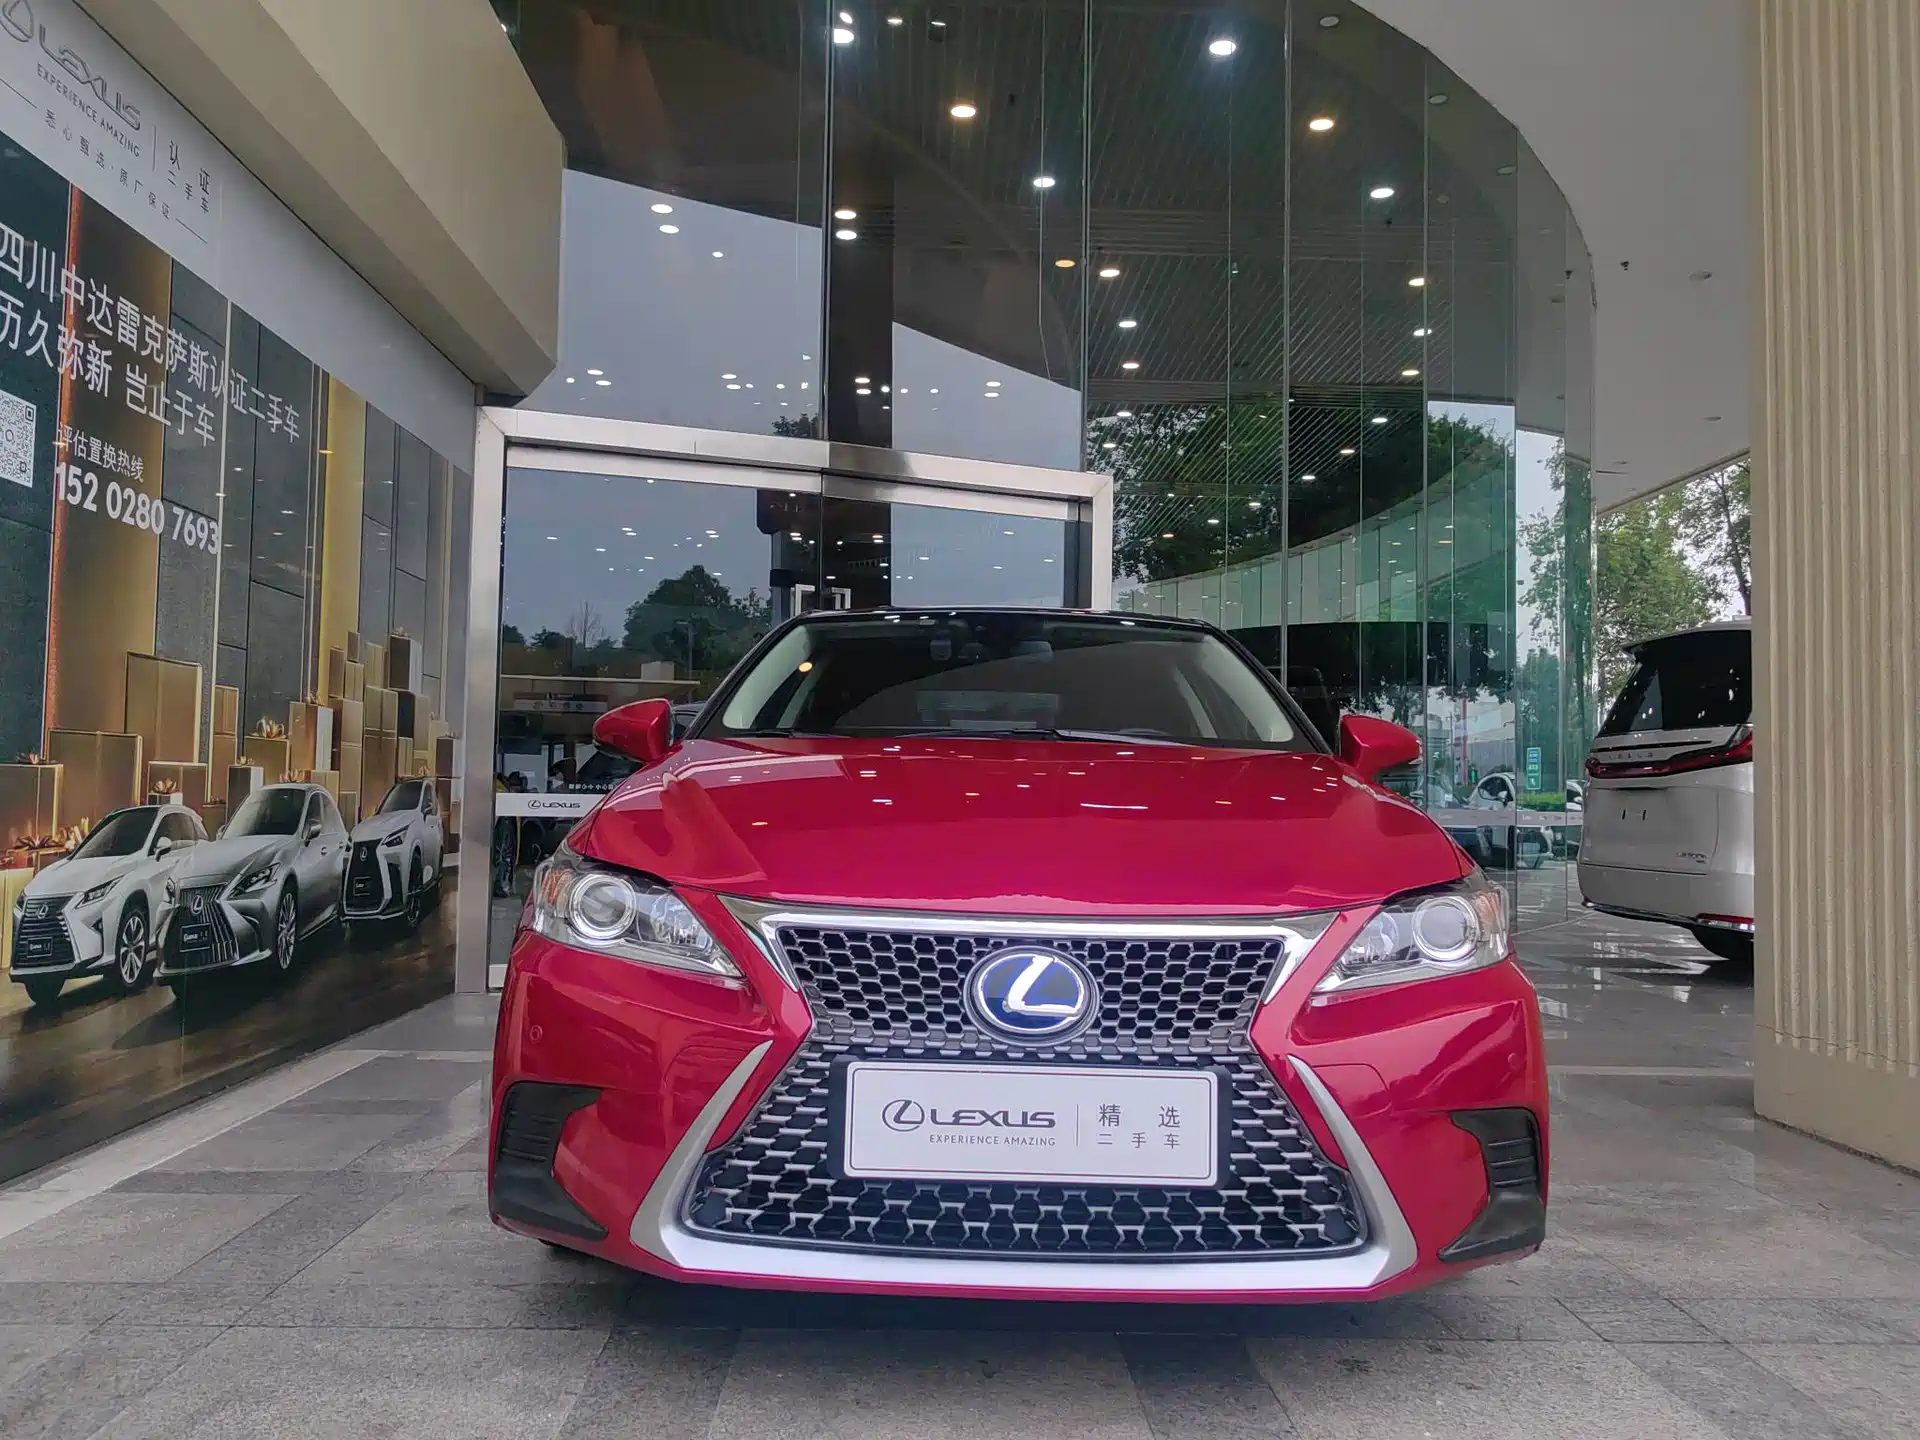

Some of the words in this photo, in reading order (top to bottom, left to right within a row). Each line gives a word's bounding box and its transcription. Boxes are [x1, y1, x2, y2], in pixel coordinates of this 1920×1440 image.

[39, 23, 141, 131] LEXUS
[36, 62, 98, 123] EXPERIENCE
[100, 117, 141, 158] AMAZING
[166, 169, 210, 215] 二手车
[168, 139, 211, 196] 认证
[0, 222, 300, 444] 四川中达雷克萨斯认证二手车
[124, 362, 216, 448] 岂止于车
[57, 421, 145, 484] 评估置换热线
[55, 461, 99, 513] 152
[105, 481, 165, 535] 0280
[172, 506, 220, 556] 7693
[542, 801, 581, 809] LEXUS
[929, 1107, 1056, 1129] LEXUS
[929, 1134, 999, 1146] EXPERIENCE
[1003, 1136, 1057, 1147] AMAZING
[1096, 1131, 1181, 1150] 二手车
[1098, 1103, 1181, 1129] 精选
